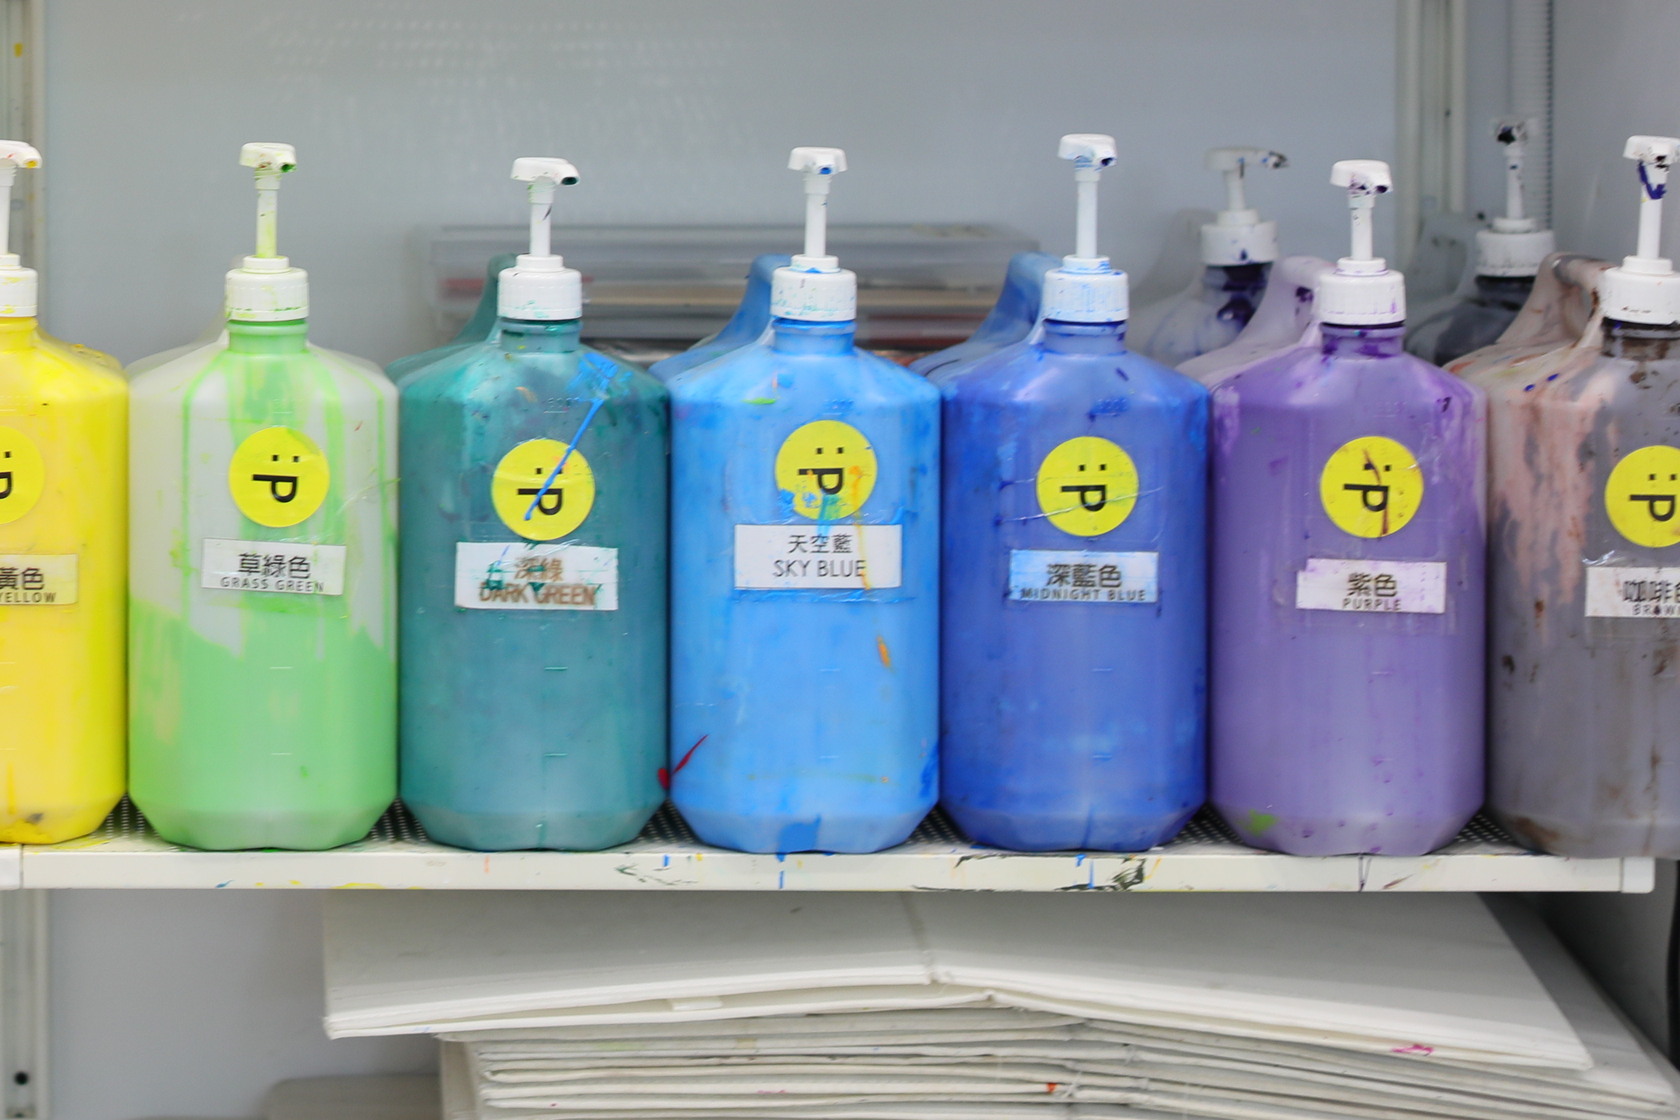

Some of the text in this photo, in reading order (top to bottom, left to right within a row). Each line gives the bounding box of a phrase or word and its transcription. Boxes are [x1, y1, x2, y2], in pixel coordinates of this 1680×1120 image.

[788, 533, 853, 553] 天空藍
[238, 552, 311, 579] 草綠色
[773, 560, 867, 577] SKY BLUE
[1046, 563, 1122, 588] 深藍色
[220, 577, 324, 593] GRASS GREEN
[1347, 573, 1397, 597] 紫色
[1020, 588, 1146, 601] MIDNIGHT BLUE
[1342, 597, 1402, 611] PURPLE
